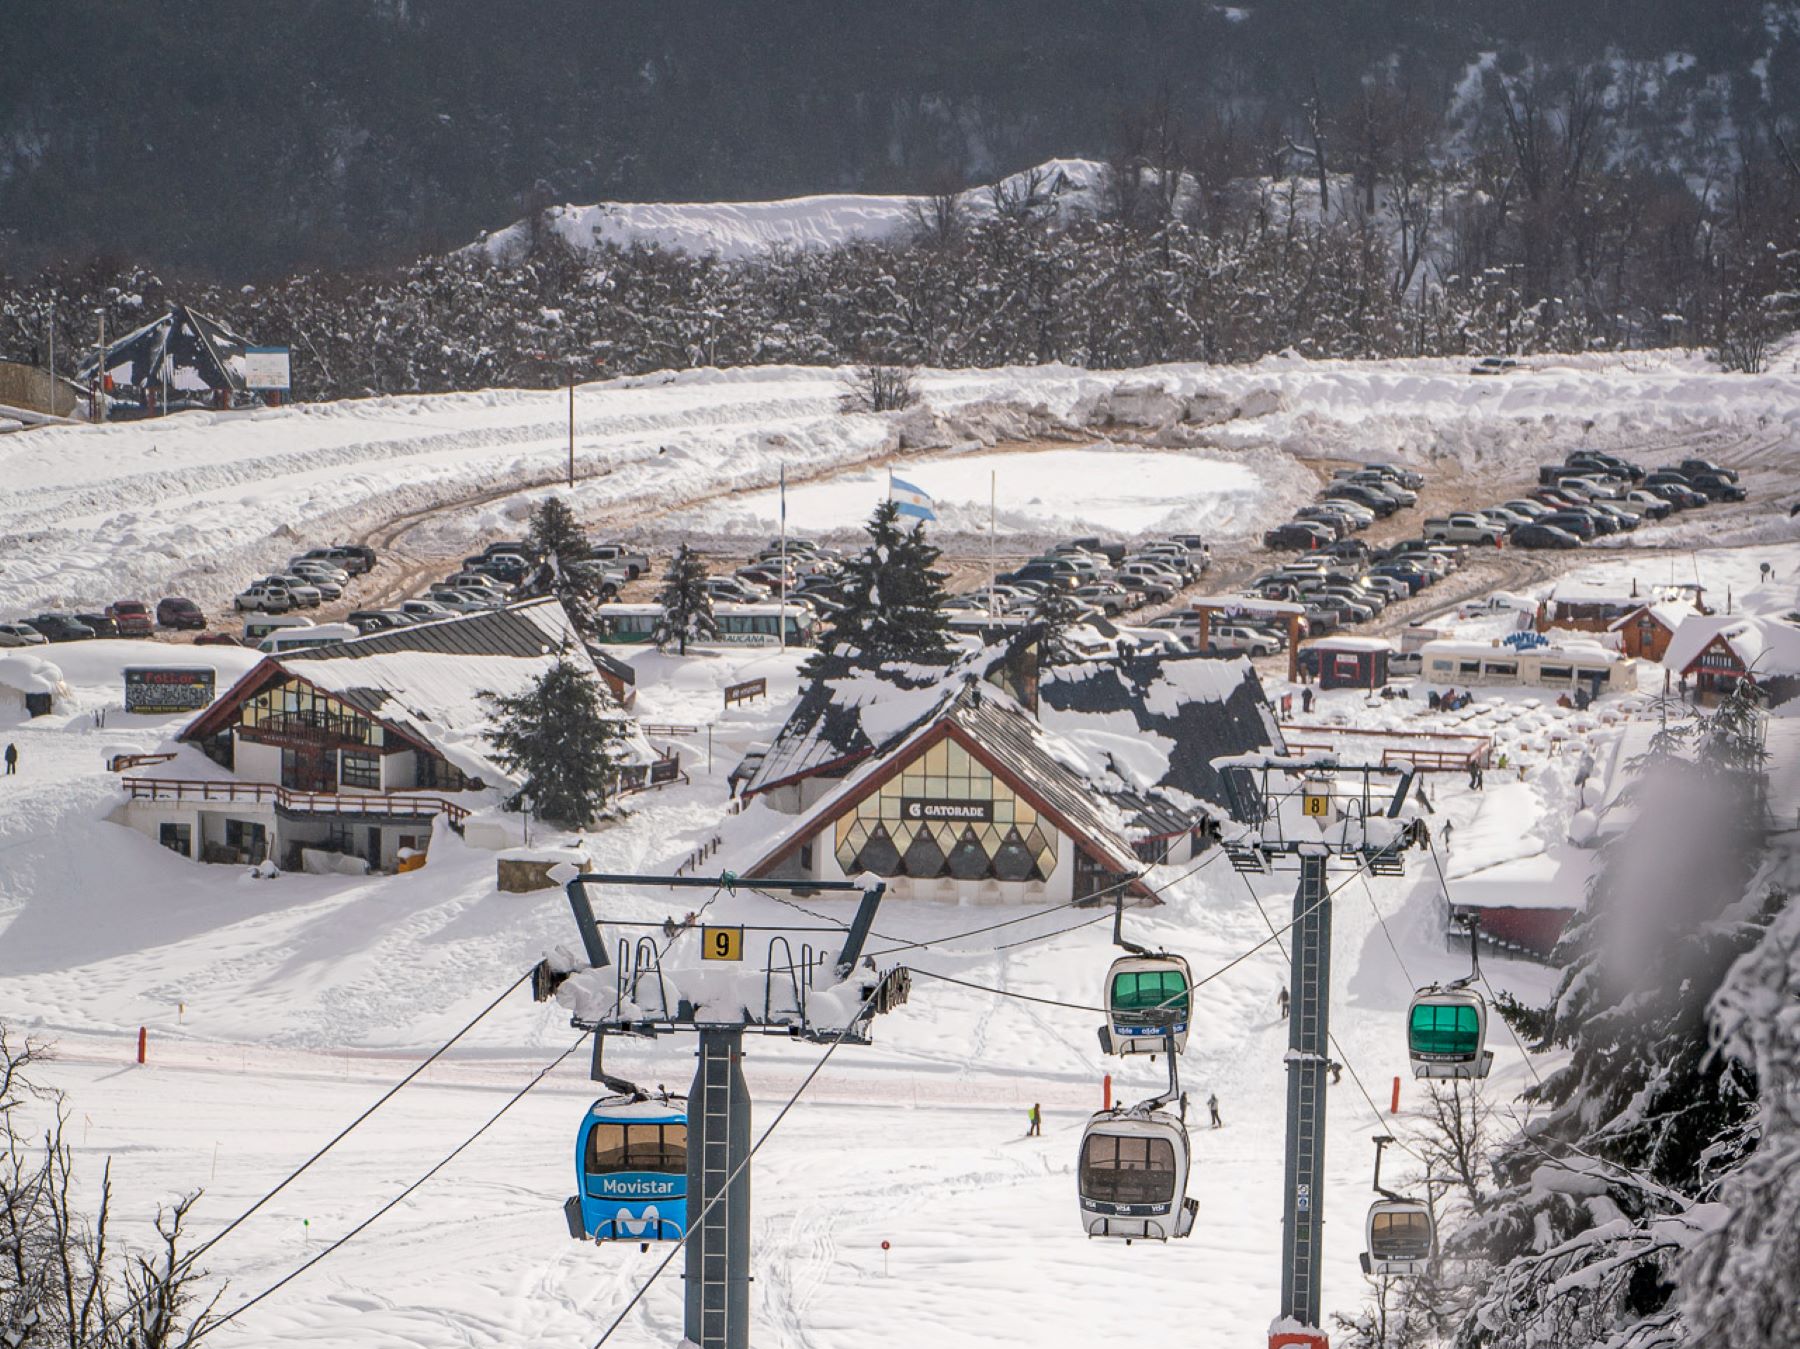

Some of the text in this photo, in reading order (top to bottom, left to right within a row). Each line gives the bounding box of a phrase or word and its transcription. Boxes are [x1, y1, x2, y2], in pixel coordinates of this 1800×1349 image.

[924, 805, 984, 817] GATORADE
[1311, 797, 1320, 813] 8
[716, 932, 730, 957] 9
[603, 1179, 674, 1194] Movistar
